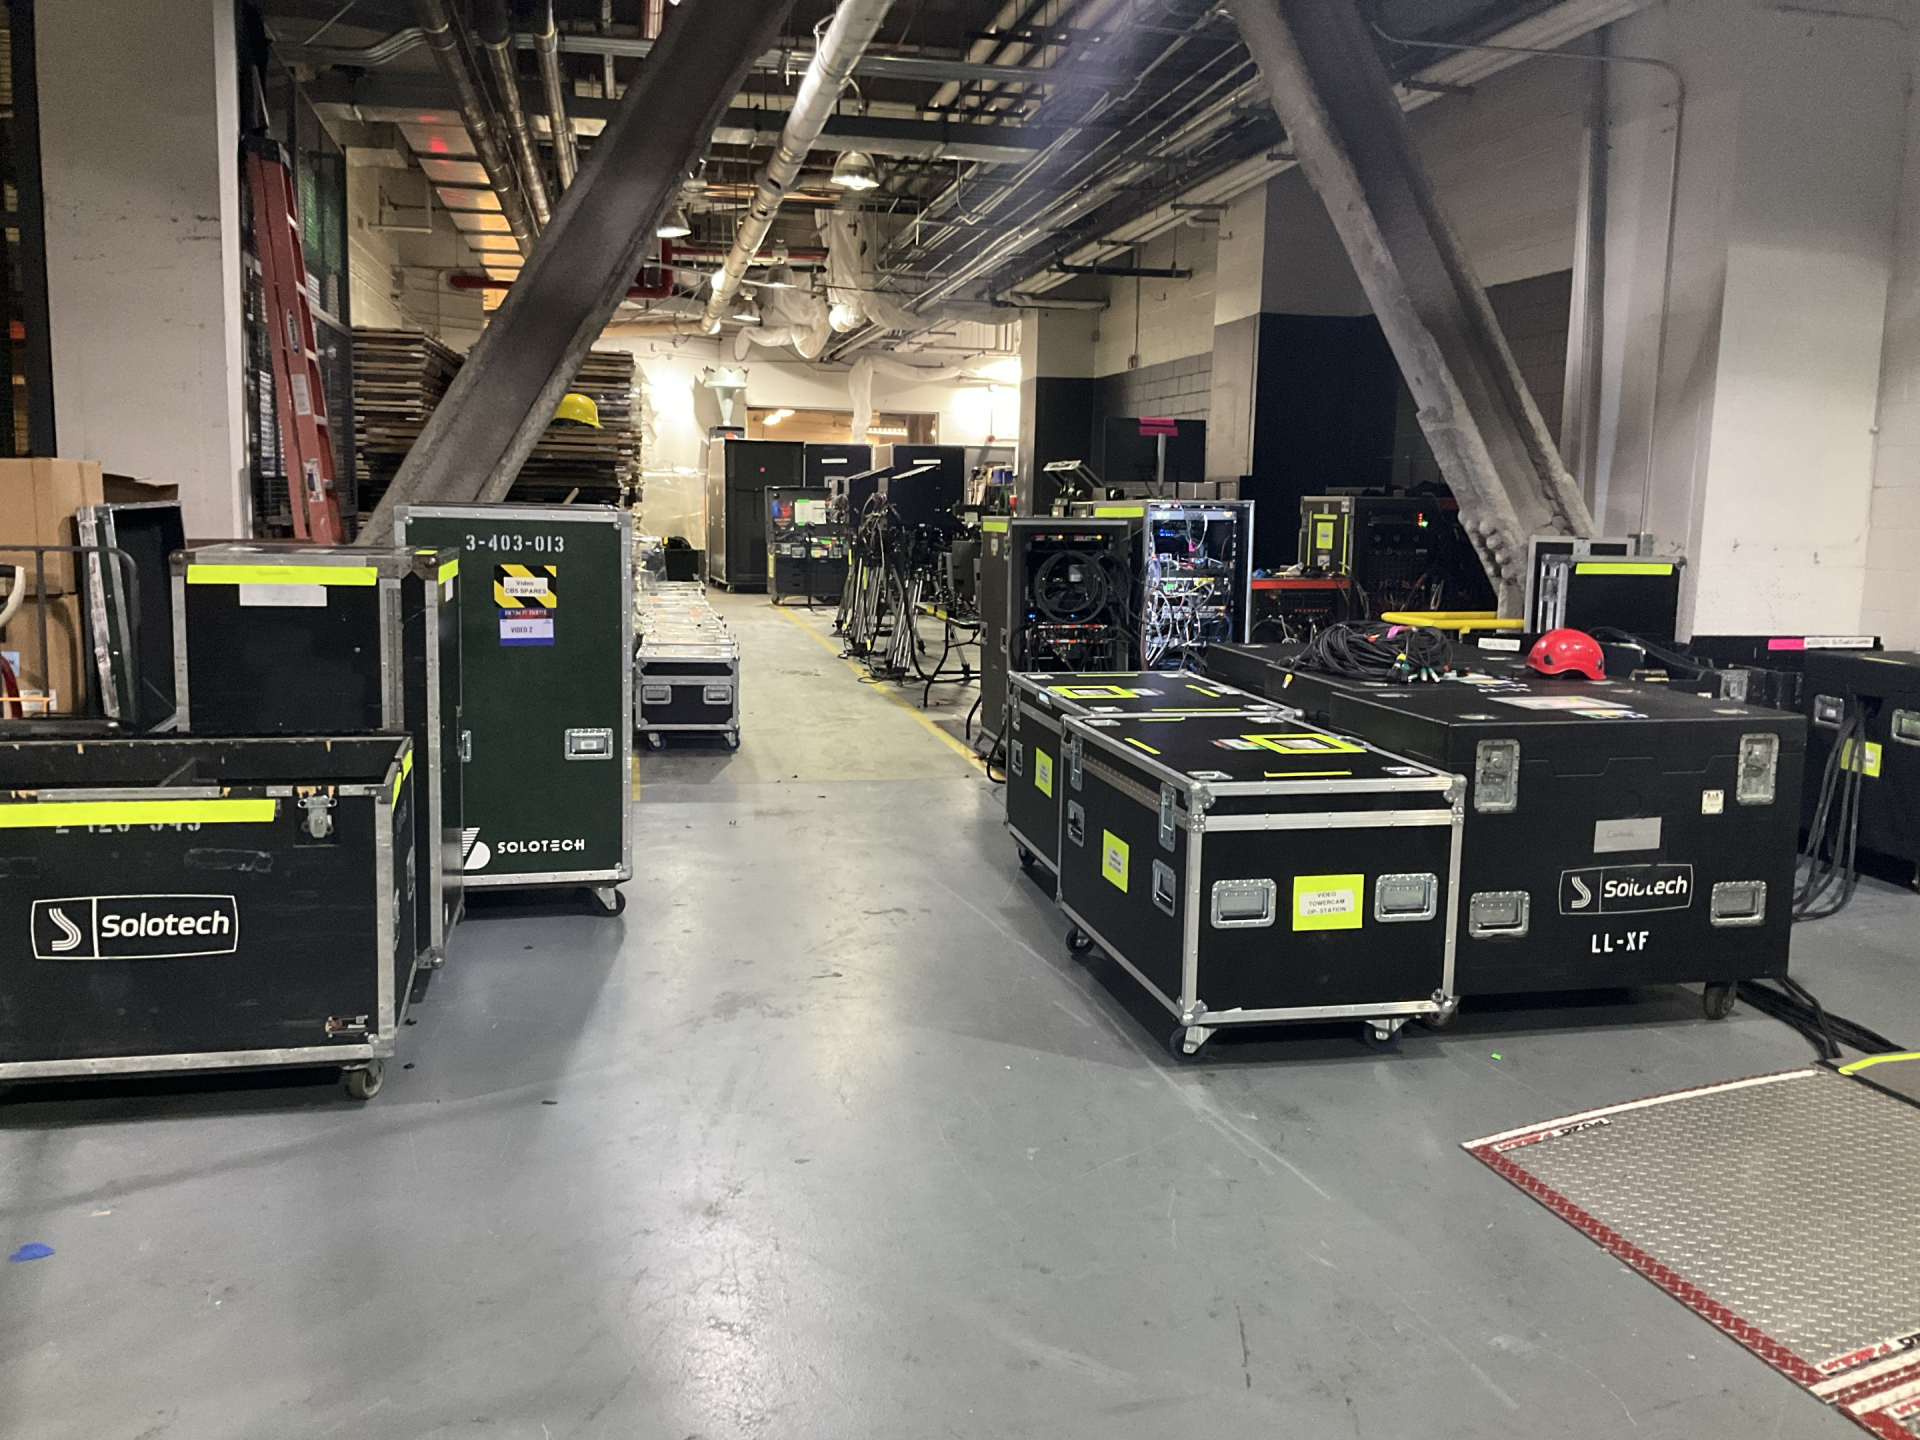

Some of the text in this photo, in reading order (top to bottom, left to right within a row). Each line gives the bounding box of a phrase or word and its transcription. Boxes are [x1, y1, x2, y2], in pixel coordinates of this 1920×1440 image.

[466, 534, 564, 552] 3-403-013
[498, 839, 585, 854] SOLOTECH
[1309, 899, 1345, 907] TOWERCAM
[101, 911, 229, 938] Solotech
[1591, 931, 1649, 953] LL-XF
